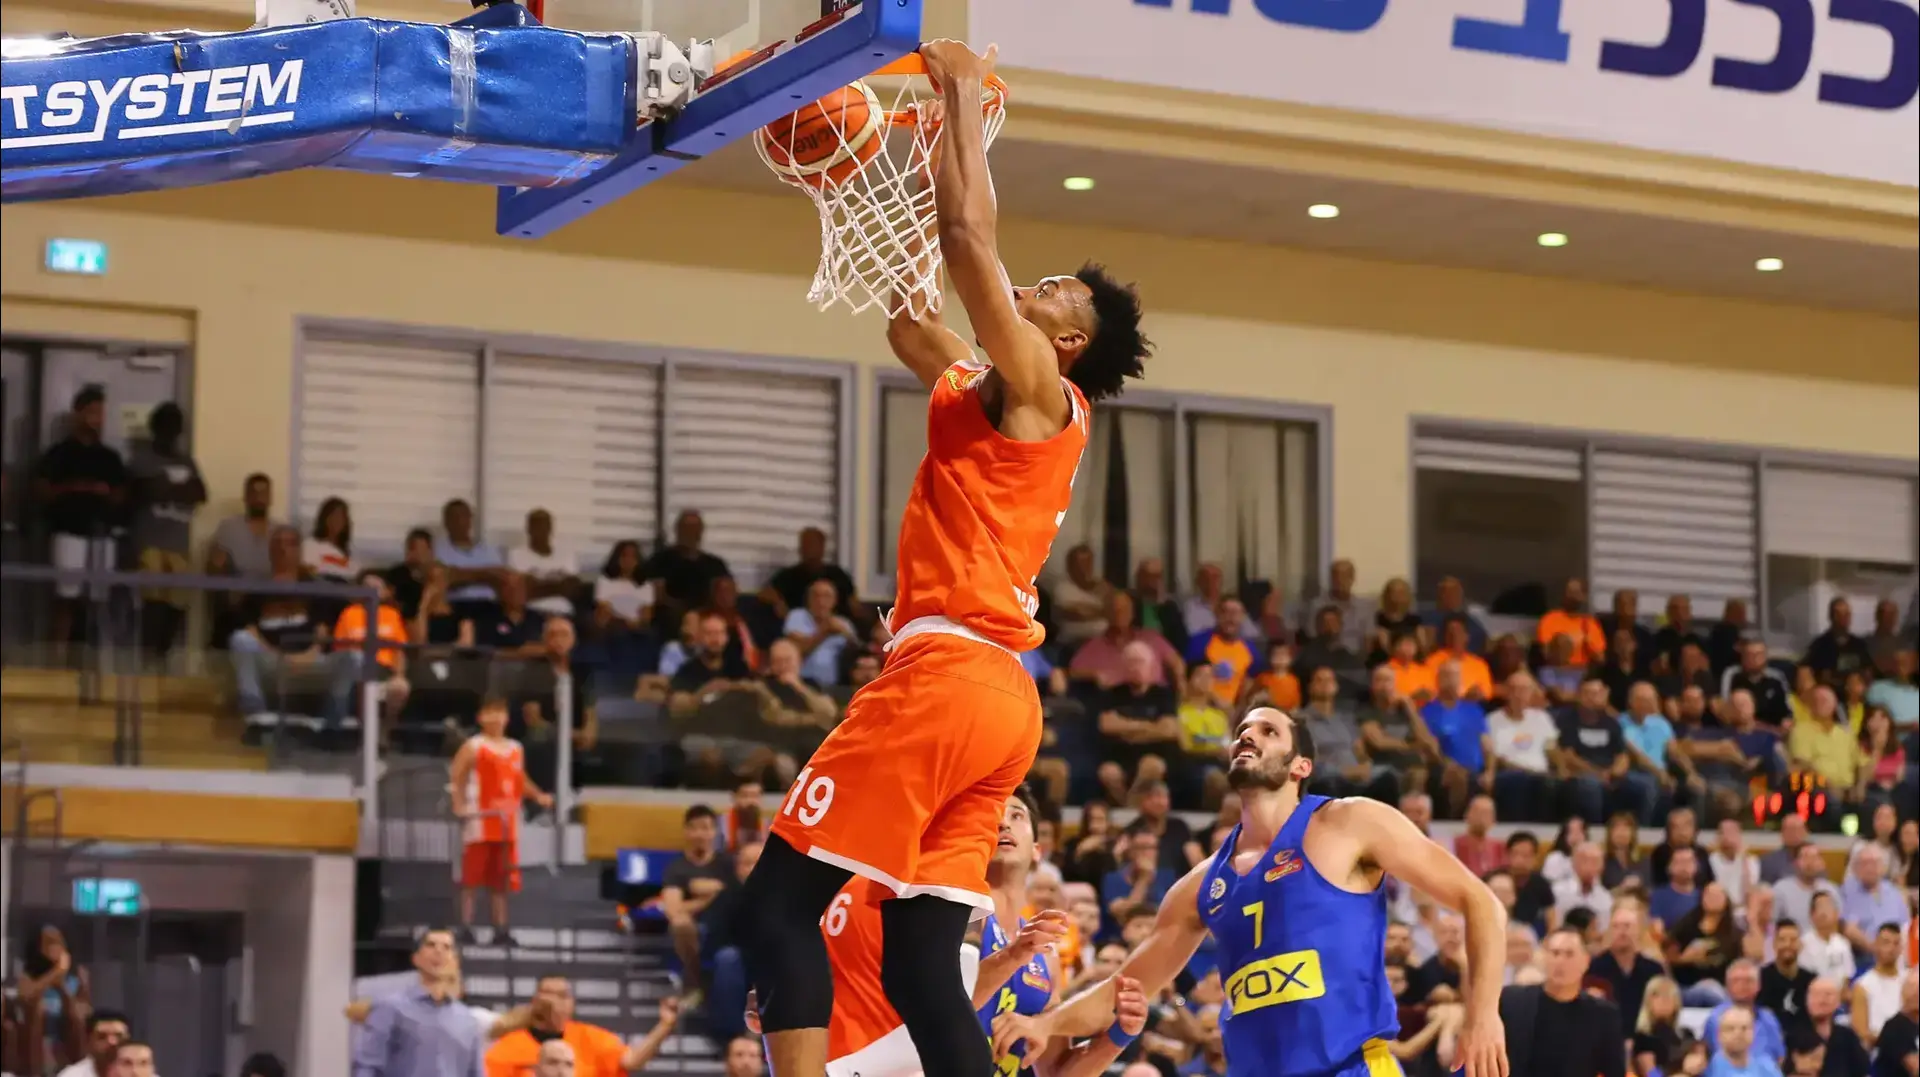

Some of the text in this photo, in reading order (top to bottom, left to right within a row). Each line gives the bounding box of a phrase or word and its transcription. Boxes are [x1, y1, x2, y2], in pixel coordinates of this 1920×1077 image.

[41, 59, 303, 140] SYSTEM
[783, 766, 835, 826] 19
[819, 893, 852, 937] 6
[1242, 900, 1264, 949] 7
[1231, 961, 1310, 1007] FOX
